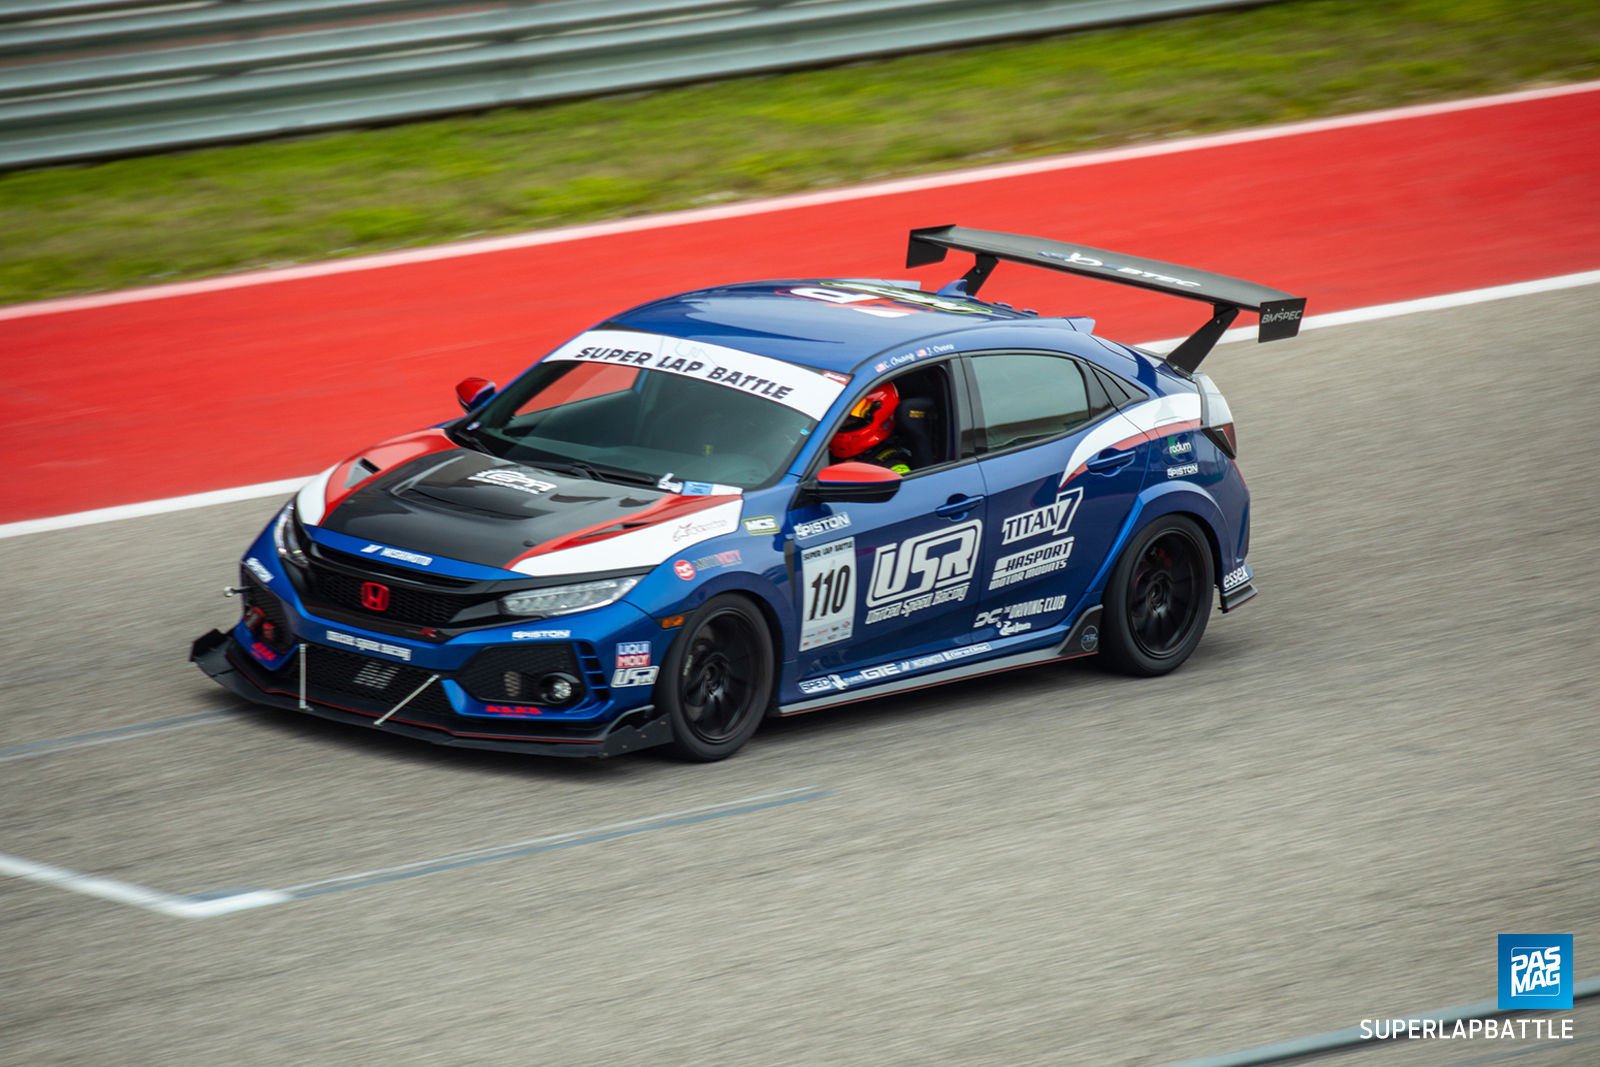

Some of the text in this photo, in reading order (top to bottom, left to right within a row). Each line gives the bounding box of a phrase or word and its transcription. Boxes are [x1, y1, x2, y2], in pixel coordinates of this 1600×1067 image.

[1261, 310, 1302, 324] BMSPEC
[575, 347, 794, 400] SUPER LAP BATTLE
[745, 517, 777, 531] MCS
[803, 544, 821, 560] SUPER
[1004, 542, 1071, 572] HASPORT
[1223, 565, 1248, 588] essex
[809, 564, 851, 620] 110
[1043, 595, 1067, 612] CLUB
[618, 643, 650, 655] LIQUI
[618, 654, 650, 667] MOLY
